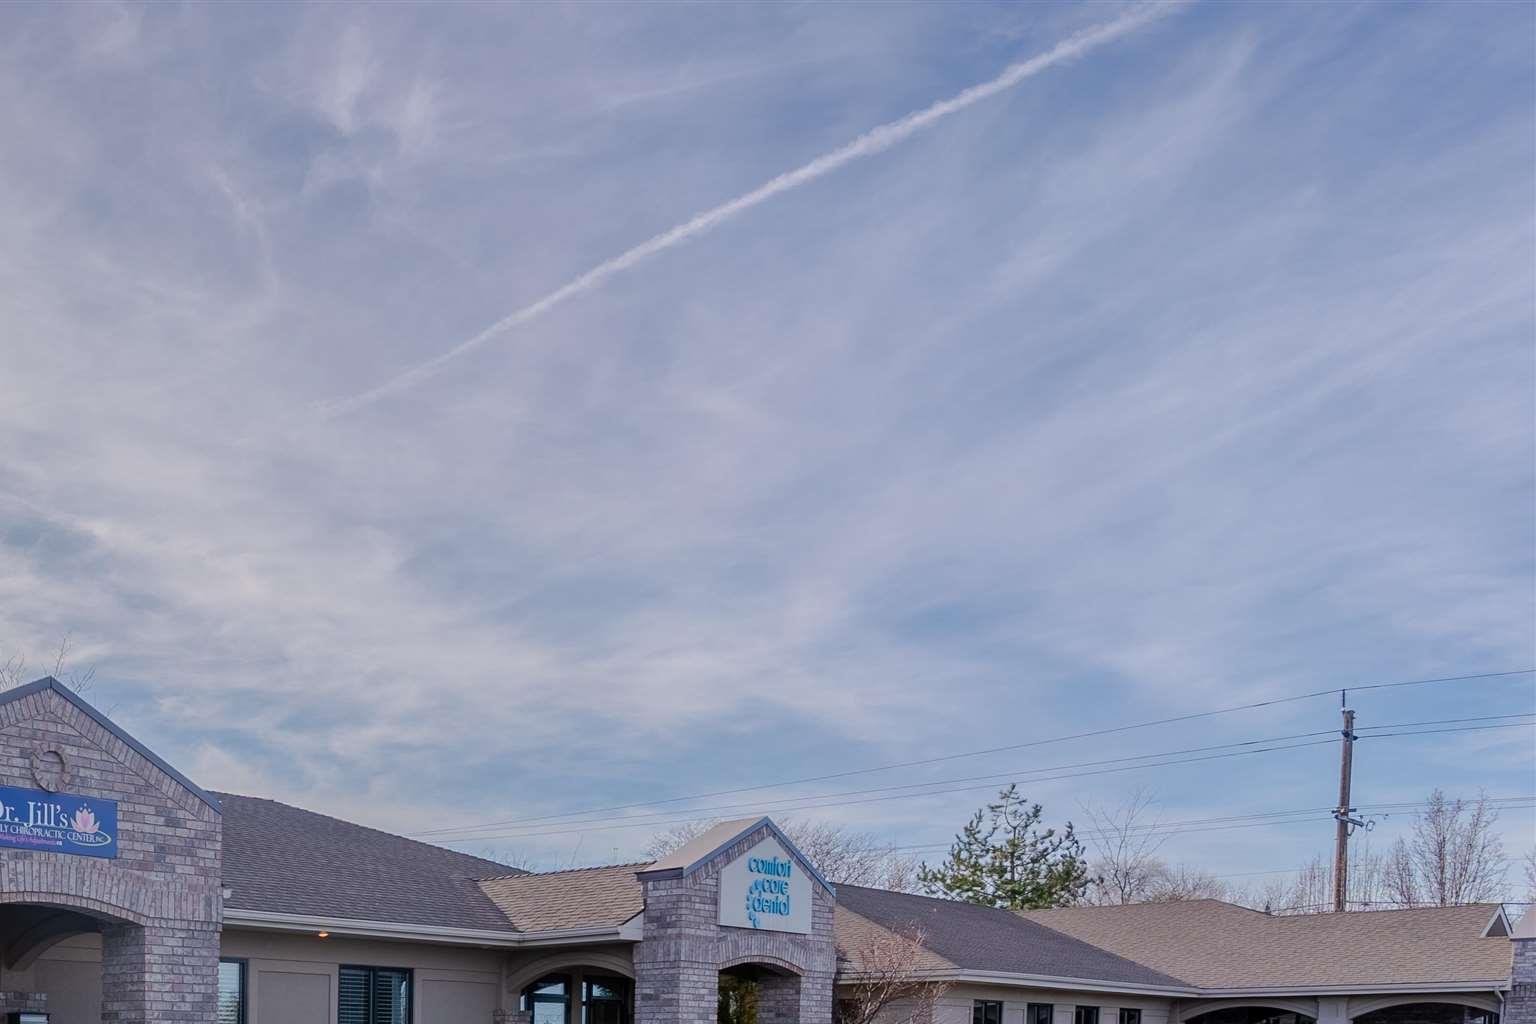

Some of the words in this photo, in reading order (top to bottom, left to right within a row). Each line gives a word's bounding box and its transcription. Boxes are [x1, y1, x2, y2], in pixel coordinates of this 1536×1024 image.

[24, 801, 68, 829] Jill's
[9, 825, 66, 840] CHIROPRACTIC
[67, 831, 95, 842] CENTER
